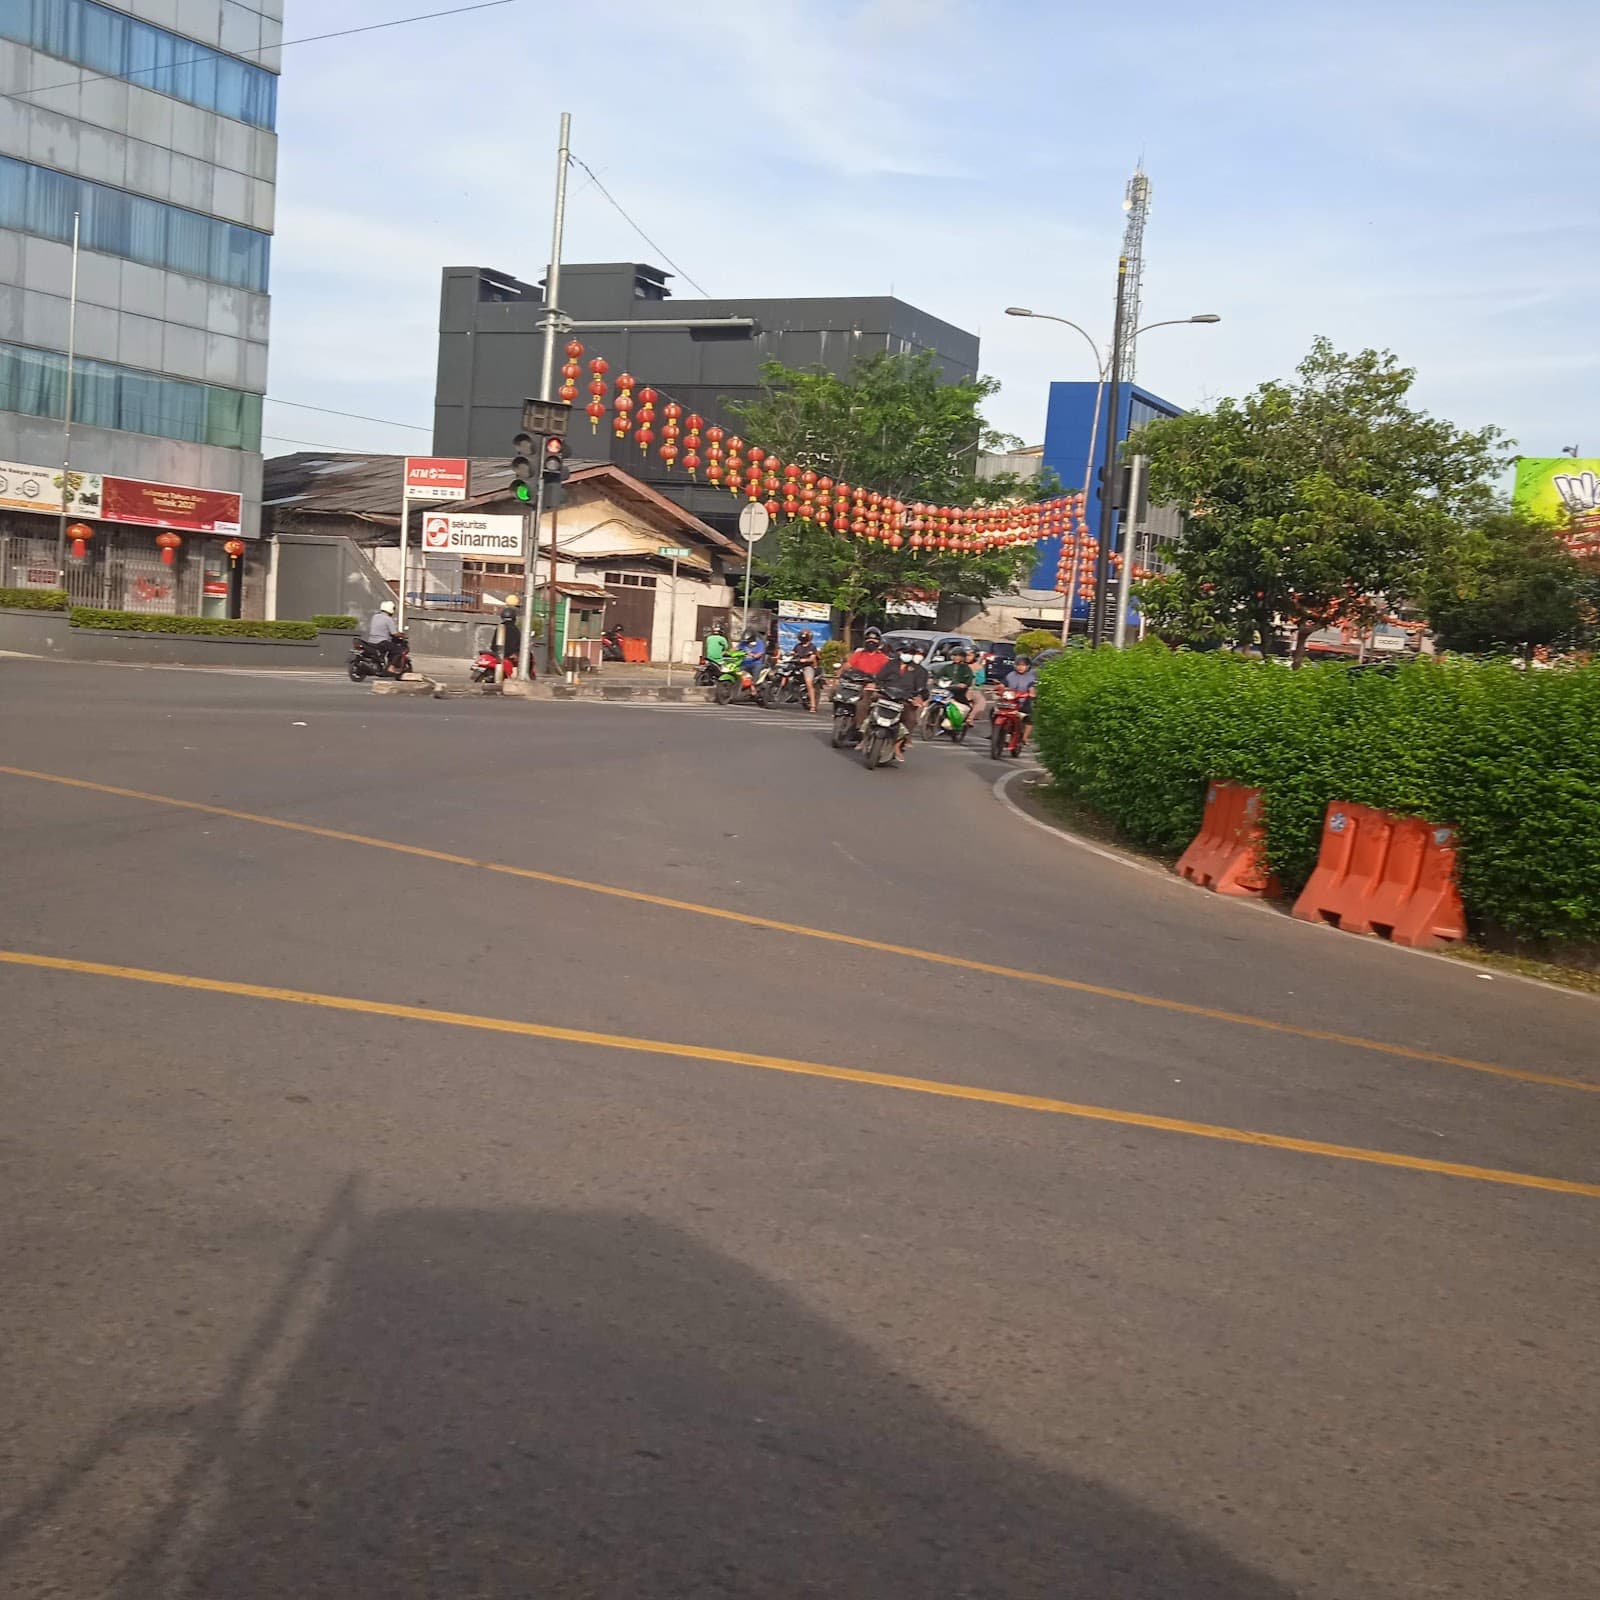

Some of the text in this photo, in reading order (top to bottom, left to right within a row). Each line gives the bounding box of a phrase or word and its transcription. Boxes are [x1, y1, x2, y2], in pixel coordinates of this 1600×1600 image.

[409, 469, 429, 478] ATM
[452, 520, 487, 529] sekuritas
[451, 530, 518, 548] sinarmas
